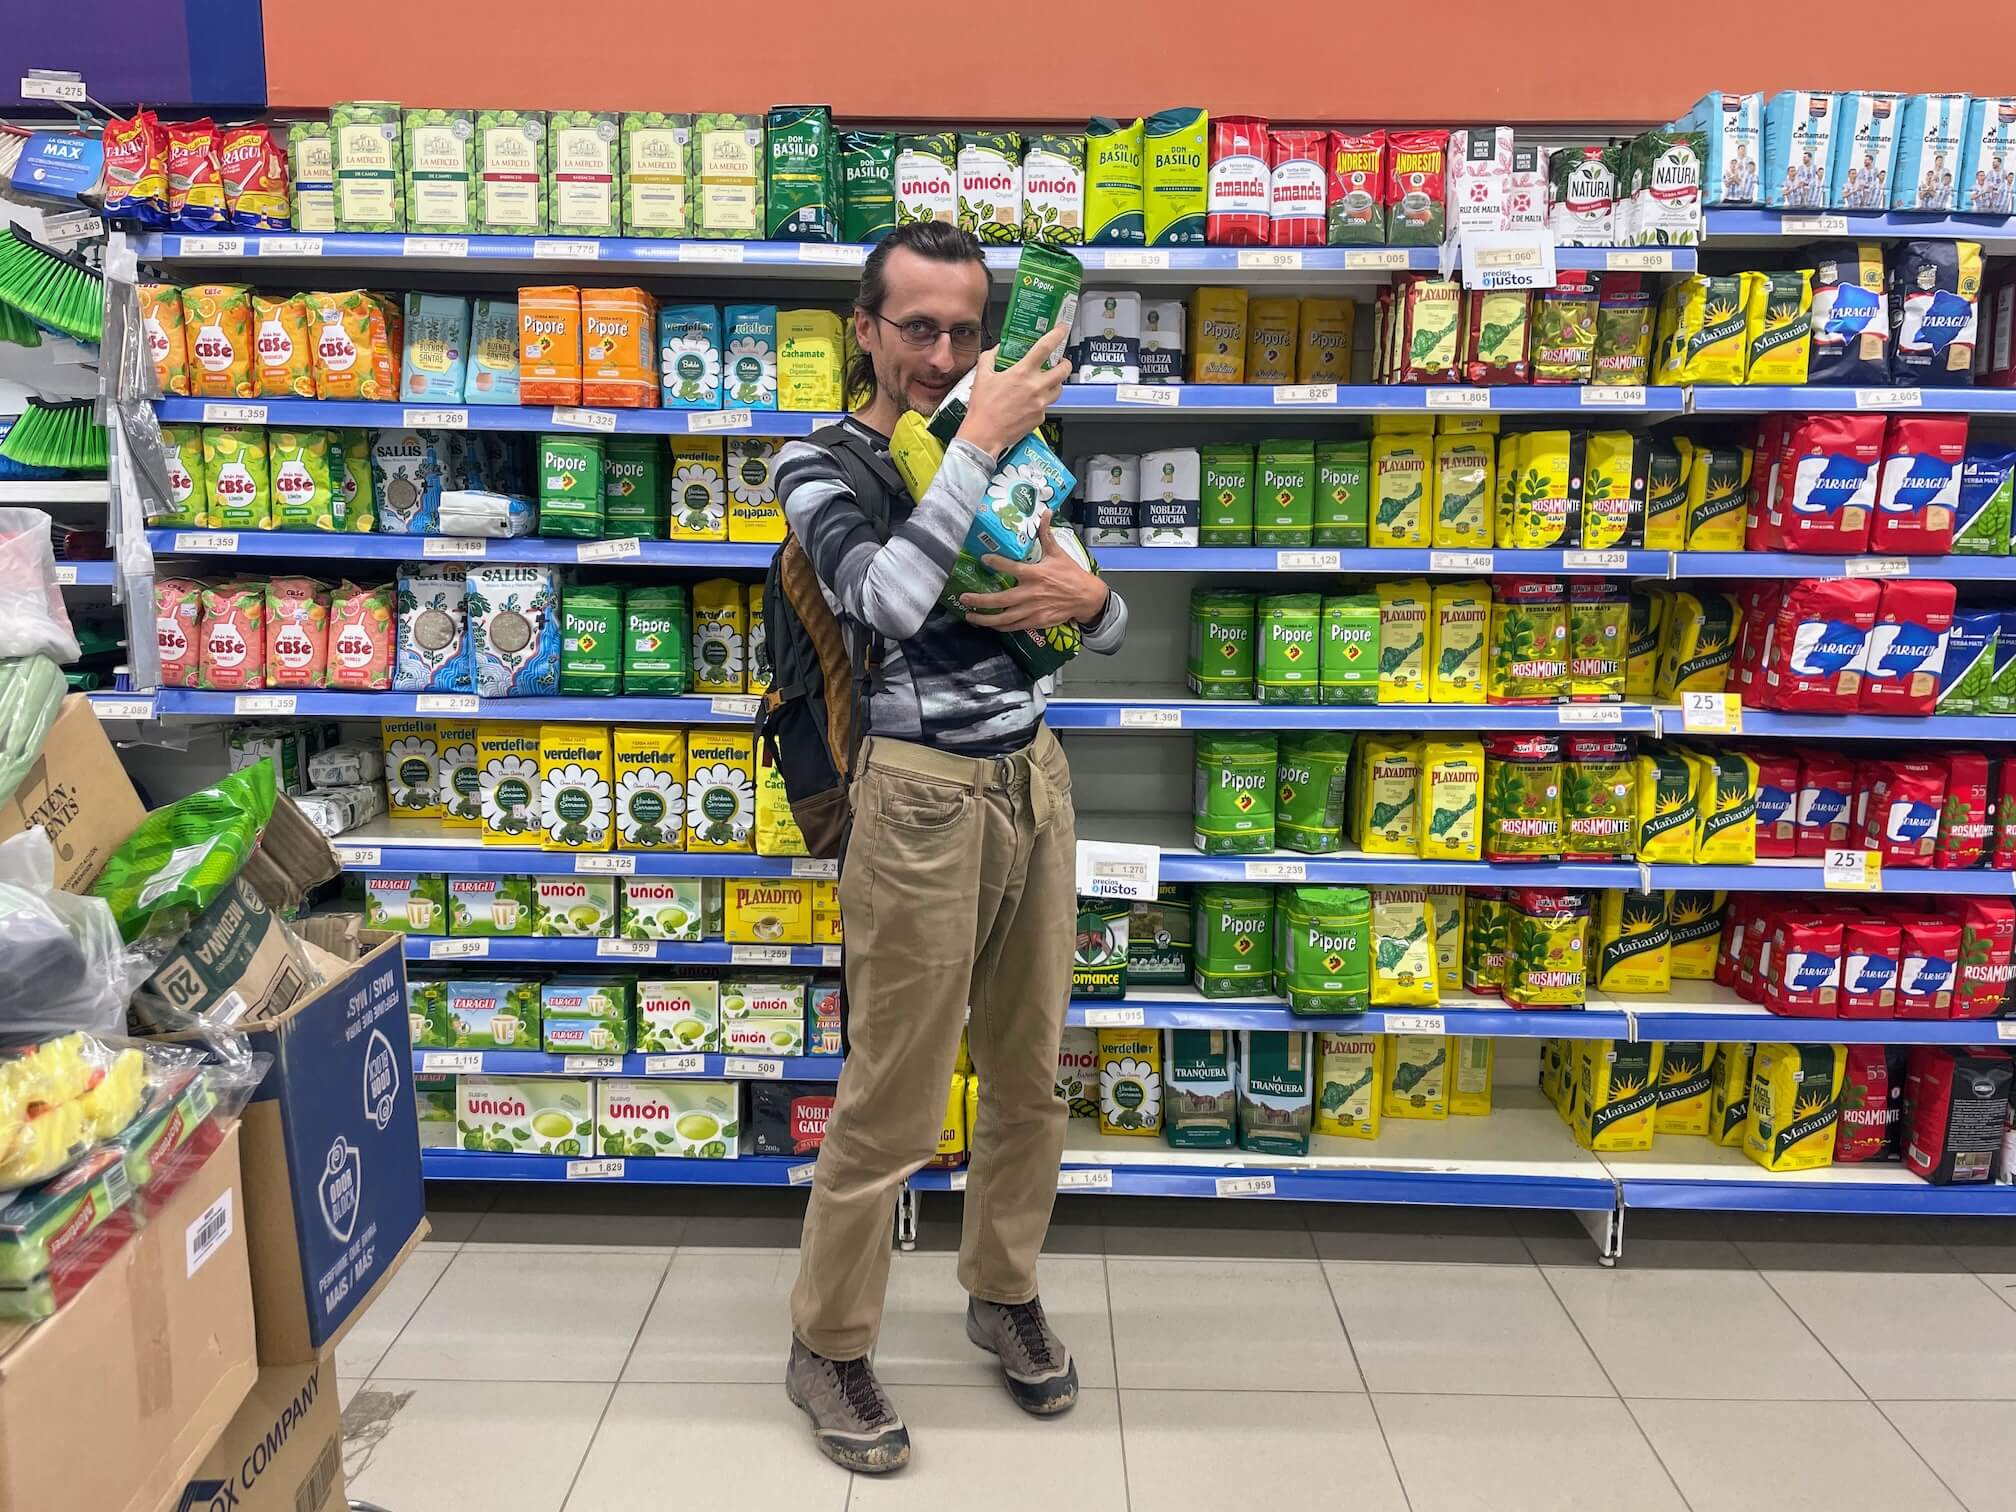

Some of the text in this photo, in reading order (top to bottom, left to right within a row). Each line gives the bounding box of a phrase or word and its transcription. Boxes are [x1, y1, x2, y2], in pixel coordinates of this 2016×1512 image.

[55, 86, 83, 97] 4.275
[1724, 125, 1759, 135] Cachamate
[1792, 131, 1829, 140] Cachamate
[788, 136, 804, 145] DON
[1855, 135, 1892, 144] Cachamate
[1924, 136, 1959, 145] Cachamate
[43, 142, 82, 159] MAX
[773, 143, 818, 159] BASILIO
[1114, 143, 1128, 152] DON
[1172, 146, 1187, 154] DON
[345, 156, 386, 164] LA MERCED
[420, 158, 460, 167] LA MERCED
[492, 159, 531, 167] LA MERCED
[564, 160, 604, 168] LA MERCED
[860, 159, 874, 168] DON
[1099, 151, 1140, 166] BASILIO
[1156, 154, 1201, 170] BASILIO
[1336, 151, 1379, 174] ANDRESITO
[1396, 151, 1440, 174] ANDRESITO
[847, 166, 888, 183] BASILIO
[1656, 166, 1696, 191] NATURA
[1216, 179, 1264, 198] amanda
[1273, 184, 1322, 202] amanda
[1481, 206, 1501, 217] MALTA
[74, 220, 101, 234] 3.489
[1818, 220, 1844, 230] 1.235
[217, 240, 238, 250] 539
[1273, 255, 1294, 265] 995
[1378, 254, 1405, 264] 1.005
[1642, 255, 1662, 266] 969
[1482, 270, 1511, 278] precios
[524, 316, 564, 337] Piporé
[588, 316, 628, 338] Piporé
[1203, 319, 1241, 339] Piporé
[1690, 318, 1745, 349] Mañanita
[1754, 322, 1809, 353] Mañanita
[258, 338, 291, 353] CBSé
[319, 340, 355, 358] CBSé
[1089, 342, 1128, 353] NOBLEZA
[195, 342, 233, 365] CBSé
[781, 350, 826, 360] Cachamate
[1090, 353, 1126, 364] GAUCHA
[1542, 348, 1589, 362] ROSAMONTE
[1152, 390, 1170, 402] 735
[1461, 392, 1488, 402] 1.805
[1614, 391, 1642, 400] 1.049
[238, 409, 265, 420] 1.359
[437, 414, 463, 424] 1.269
[588, 413, 614, 426] 1.325
[722, 413, 749, 424] 1.579
[545, 450, 586, 472] Piporé
[674, 452, 720, 464] verdeflor
[1440, 455, 1488, 474] PLAYADITO
[1378, 458, 1424, 476] PLAYADITO
[1206, 470, 1246, 488] Piporé
[1264, 470, 1304, 490] Piporé
[1320, 467, 1360, 486] Piporé
[217, 477, 255, 494] CBSé
[276, 476, 313, 492] CBSé
[1097, 504, 1133, 516] NOBLEZA
[1150, 504, 1188, 516] NOBLEZA
[1532, 498, 1582, 514] ROSAMONTE
[1592, 498, 1644, 514] ROSAMONTE
[1098, 515, 1131, 526] GAUCHA
[1151, 514, 1184, 525] GAUCHA
[208, 538, 234, 548] 1.359
[455, 541, 482, 551] 1.159
[609, 541, 636, 552] 1.325
[1310, 556, 1338, 566] 1.129
[1464, 556, 1492, 568] 1.469
[1598, 554, 1626, 564] 1.239
[482, 567, 538, 582] SALUS
[1380, 608, 1427, 625] PLAYADITO
[1440, 608, 1487, 624] PLAYADITO
[566, 614, 606, 633] Piporé
[1209, 622, 1248, 642] Piporé
[1272, 624, 1313, 644] Piporé
[1330, 624, 1372, 643] Piporé
[208, 638, 246, 655] CBSé
[276, 639, 312, 656] CBSé
[336, 638, 373, 656] CBSé
[1511, 661, 1568, 677] ROSAMONTE
[268, 698, 294, 710] 1.359
[450, 698, 476, 709] 2.129
[1692, 694, 1714, 710] 25
[1154, 712, 1179, 722] 1.399
[482, 737, 540, 752] verdeflor
[544, 748, 603, 762] verdeflor
[617, 751, 676, 764] verdeflor
[691, 748, 751, 762] verdeflor
[1373, 766, 1418, 782] PLAYADITO
[1431, 769, 1480, 787] PLAYADITO
[1221, 770, 1266, 793] Piporé
[1502, 819, 1558, 835] ROSAMONTE
[1571, 819, 1630, 834] ROSAMONTE
[1646, 806, 1695, 834] Mañanita
[354, 851, 374, 861] 975
[1834, 852, 1856, 868] 25
[606, 859, 632, 869] 3.125
[1276, 866, 1304, 876] 2.239
[736, 888, 802, 910] PLAYADITO
[195, 898, 246, 966] MEDIANA
[1221, 914, 1266, 936] Piporé
[462, 943, 481, 952] 959
[1308, 928, 1357, 953] Piporé
[632, 943, 650, 953] 959
[762, 950, 788, 958] 1.259
[166, 971, 202, 1003] 20
[1528, 972, 1582, 990] ROSAMONTE
[1415, 1020, 1441, 1030] 2.755
[1102, 1042, 1154, 1056] verdeflor
[1322, 1040, 1376, 1056] PLAYADITO
[455, 1056, 480, 1067] 1.115
[597, 1058, 616, 1068] 535
[678, 1058, 696, 1068] 436
[758, 1064, 776, 1073] 509
[1195, 1060, 1206, 1068] LA
[1175, 1067, 1227, 1079] TRANQUERA
[1866, 1064, 1887, 1080] 55
[1250, 1081, 1304, 1094] TRANQUERA
[1596, 1090, 1657, 1124] Mañanita
[1844, 1108, 1903, 1126] ROSAMONTE
[1781, 1108, 1838, 1144] Mañanita
[598, 1162, 623, 1172] 1.829
[328, 1167, 354, 1205] ODOR
[1084, 1174, 1109, 1184] 1.455
[1248, 1181, 1272, 1190] 1.959
[241, 1366, 320, 1490] COMPANY
